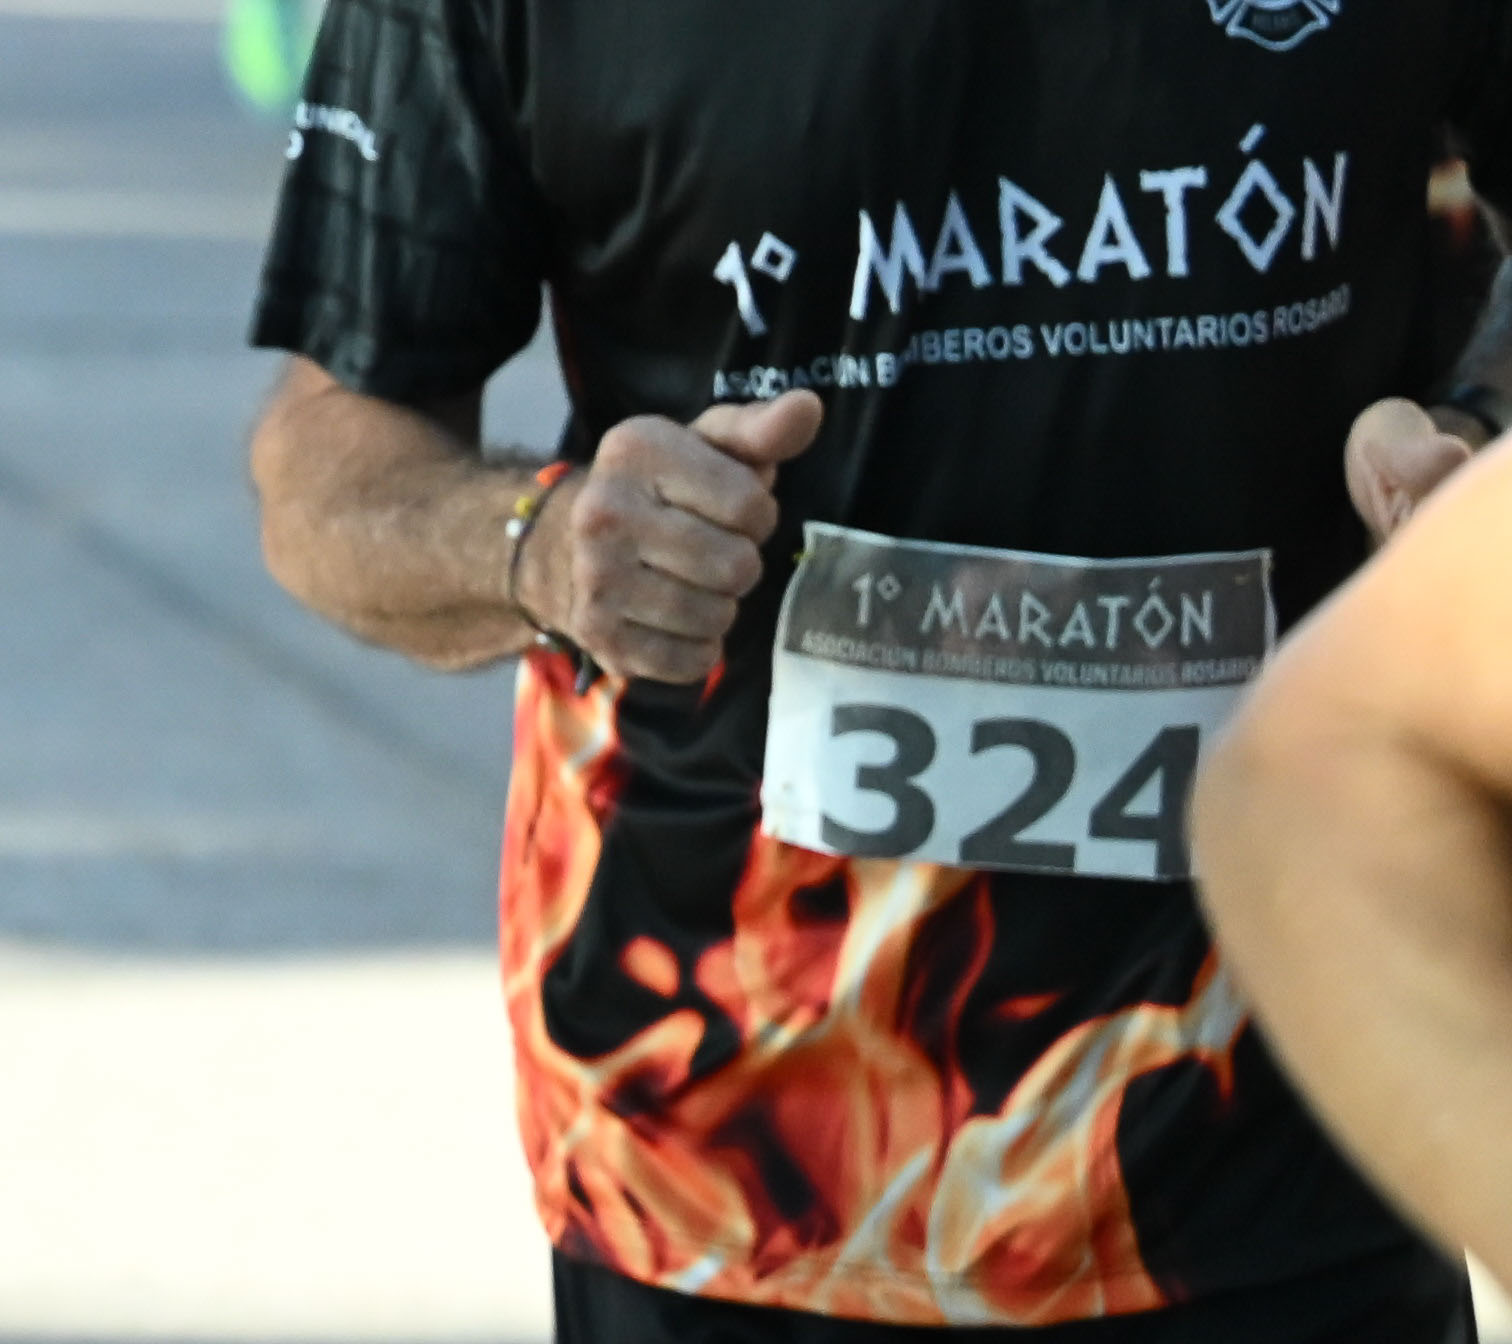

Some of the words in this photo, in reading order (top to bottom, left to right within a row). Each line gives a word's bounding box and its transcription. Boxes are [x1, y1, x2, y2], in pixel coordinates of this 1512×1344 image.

[849, 122, 1348, 320] MARATÓN
[1040, 310, 1269, 362] VOLUNTARIOS
[920, 574, 1214, 650] MARATÓN
[820, 702, 1201, 878] 324
